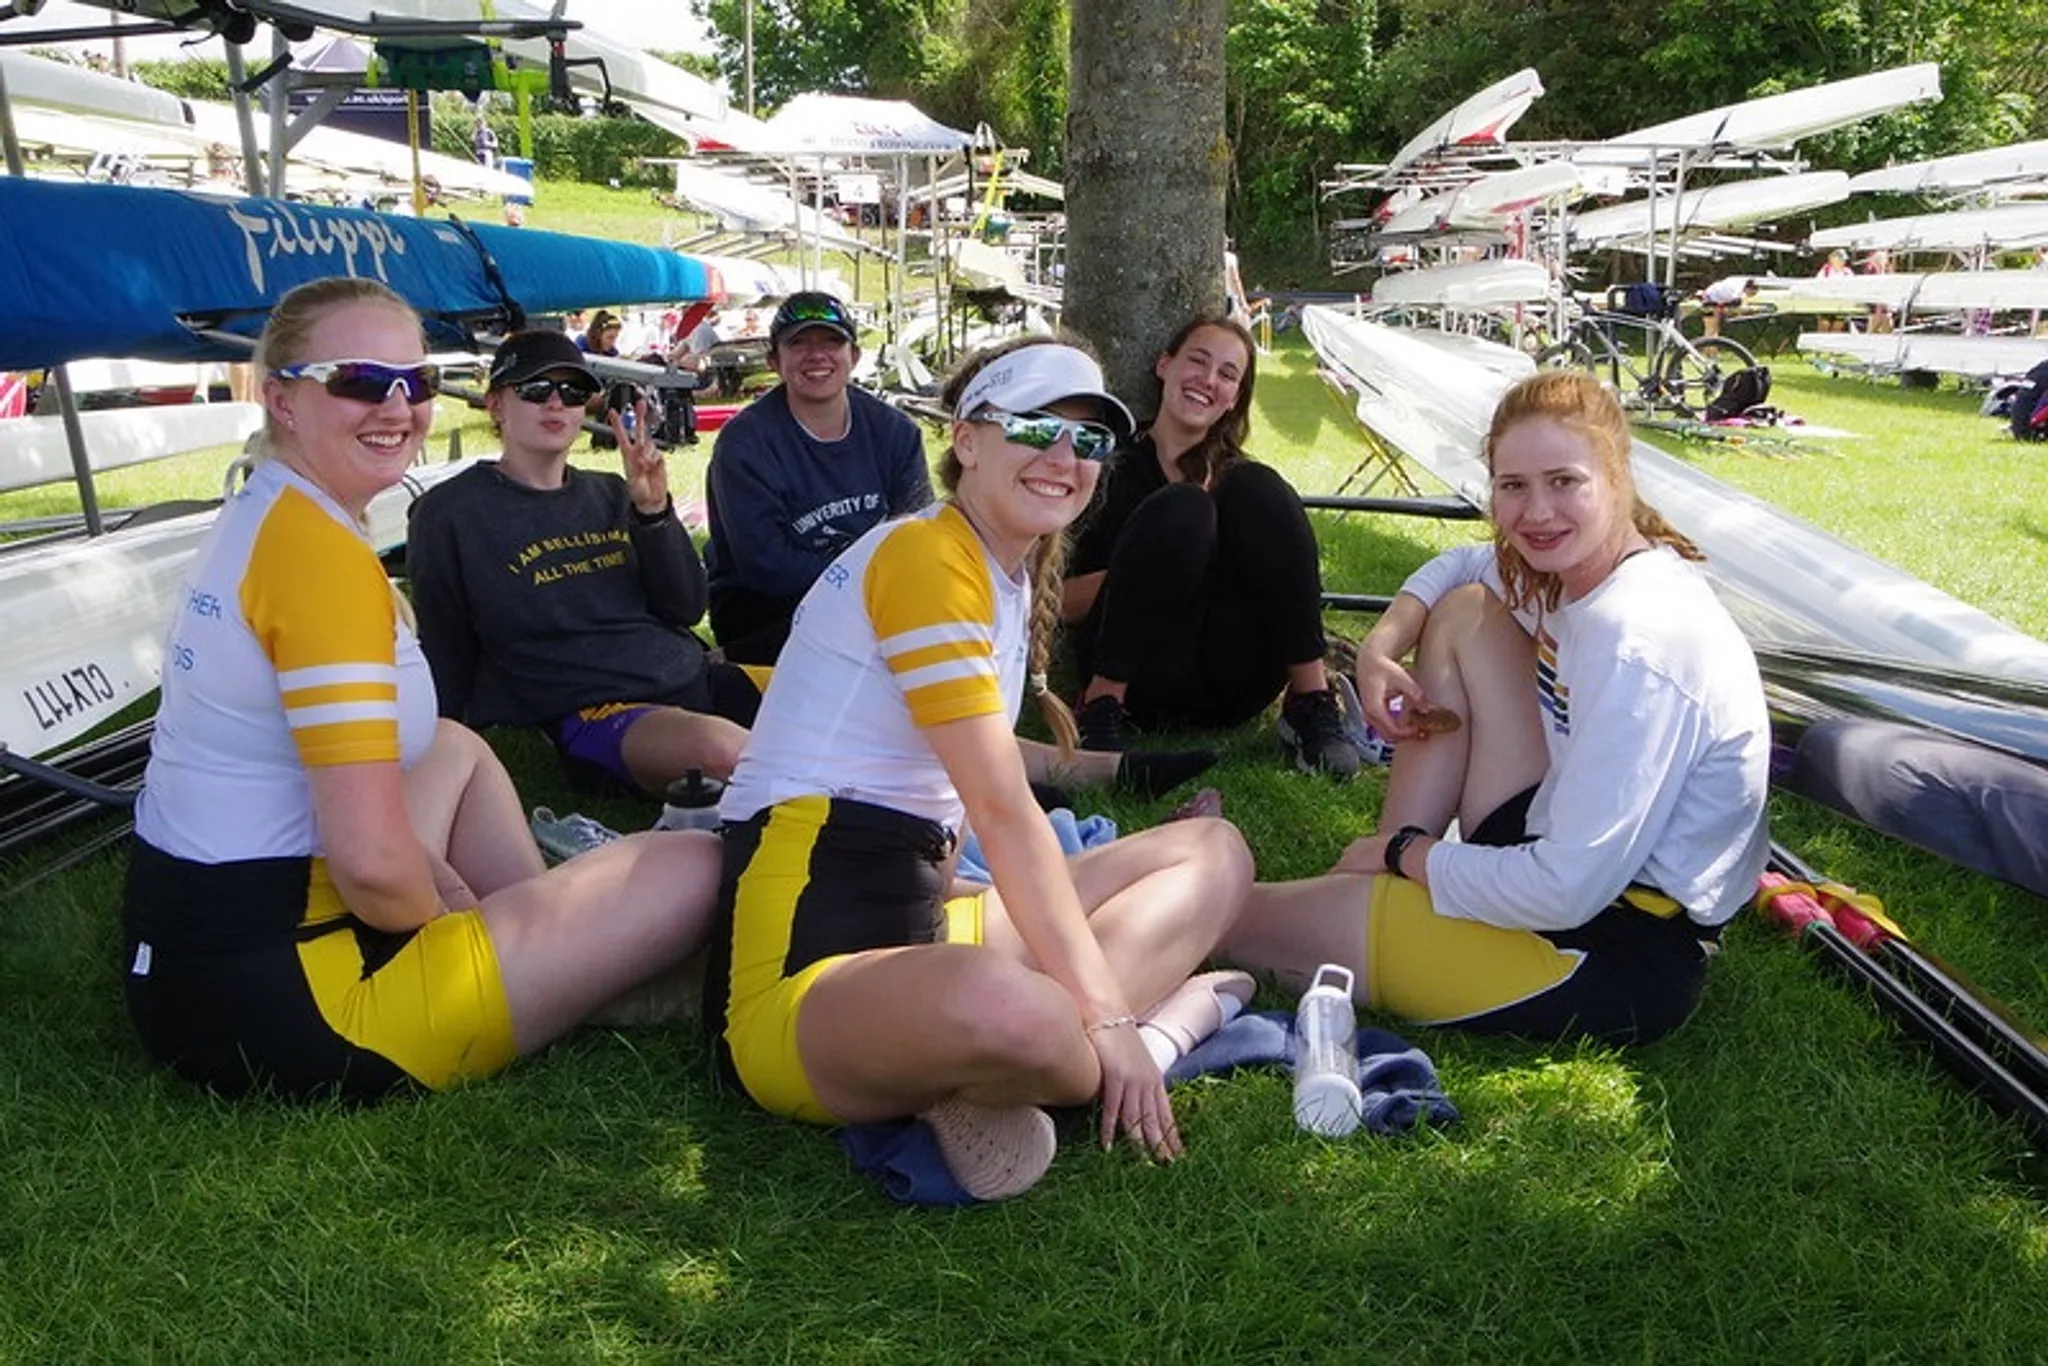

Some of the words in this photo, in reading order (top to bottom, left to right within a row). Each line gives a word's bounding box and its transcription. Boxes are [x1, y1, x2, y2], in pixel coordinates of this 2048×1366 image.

[227, 202, 405, 295] Filippi
[863, 492, 880, 511] OF
[519, 543, 542, 566] AM
[533, 566, 564, 586] ALL
[562, 559, 594, 577] THE
[23, 662, 115, 730] CLY117
